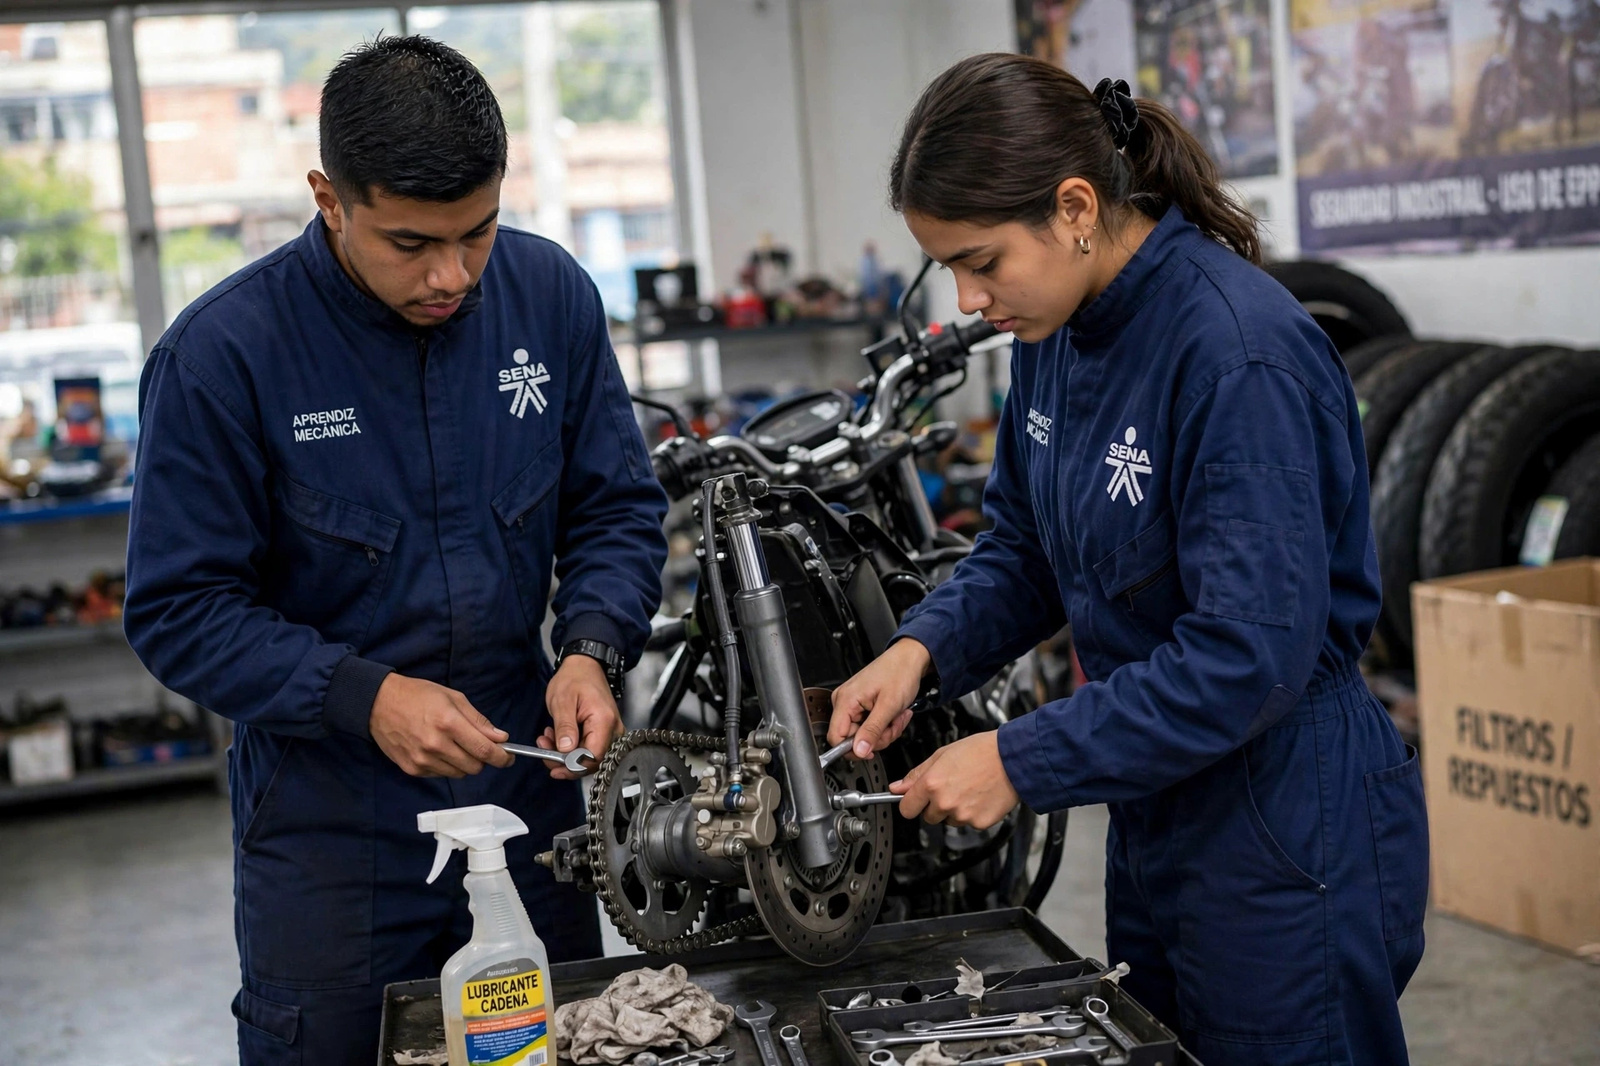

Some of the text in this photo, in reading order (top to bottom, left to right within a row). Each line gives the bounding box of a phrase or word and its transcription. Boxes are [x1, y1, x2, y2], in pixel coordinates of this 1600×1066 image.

[1498, 170, 1535, 213] USO
[1537, 167, 1563, 210] DE
[498, 362, 548, 383] SENA
[293, 407, 356, 427] APRENDIZ
[294, 421, 361, 442] MECÁNICA
[1108, 442, 1151, 465] SENA
[1456, 706, 1574, 772] FILTROS /
[1448, 755, 1592, 829] REPUESTOS
[467, 973, 538, 999] LUBRICANTE
[481, 992, 529, 1013] CADENA
